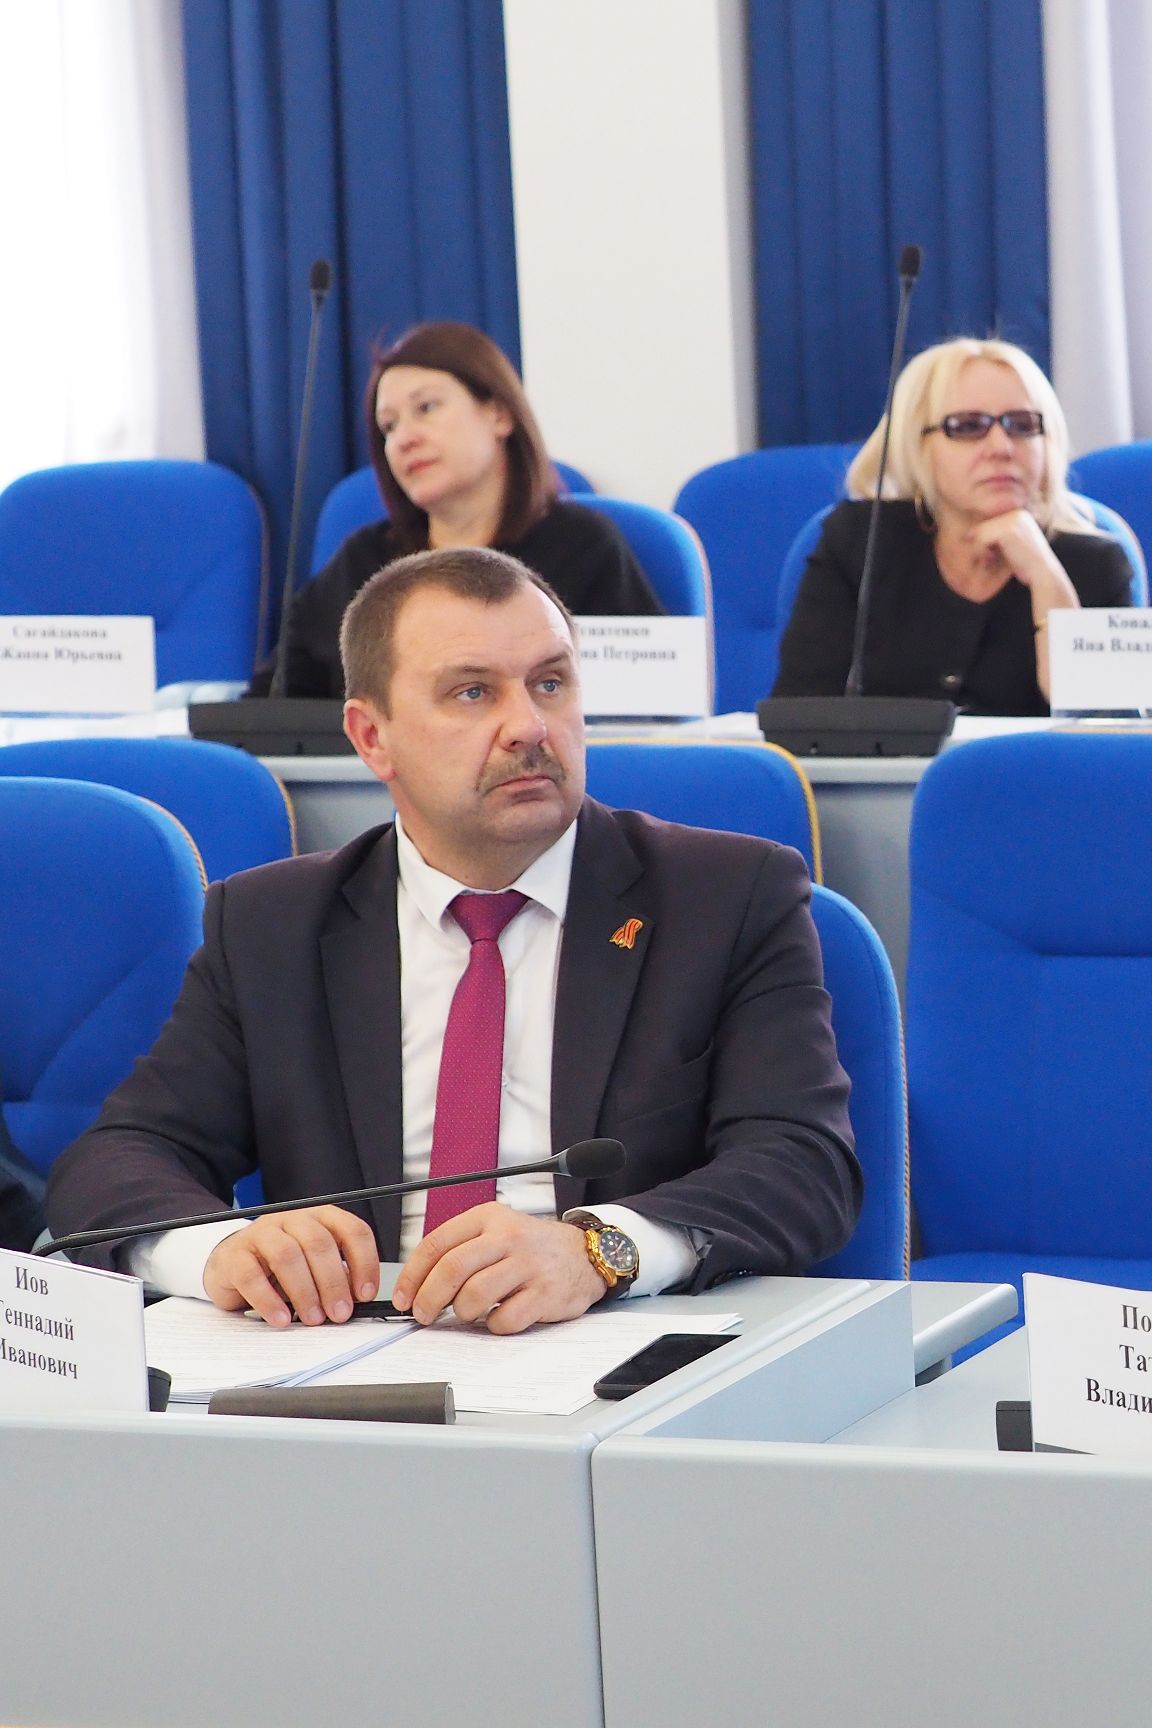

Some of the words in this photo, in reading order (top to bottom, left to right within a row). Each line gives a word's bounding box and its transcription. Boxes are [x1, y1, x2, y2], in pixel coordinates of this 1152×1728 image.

[1072, 638, 1105, 651] Яна
[54, 647, 122, 663] Юрьевна
[603, 645, 676, 662] Петровна
[15, 1266, 49, 1296] Иов
